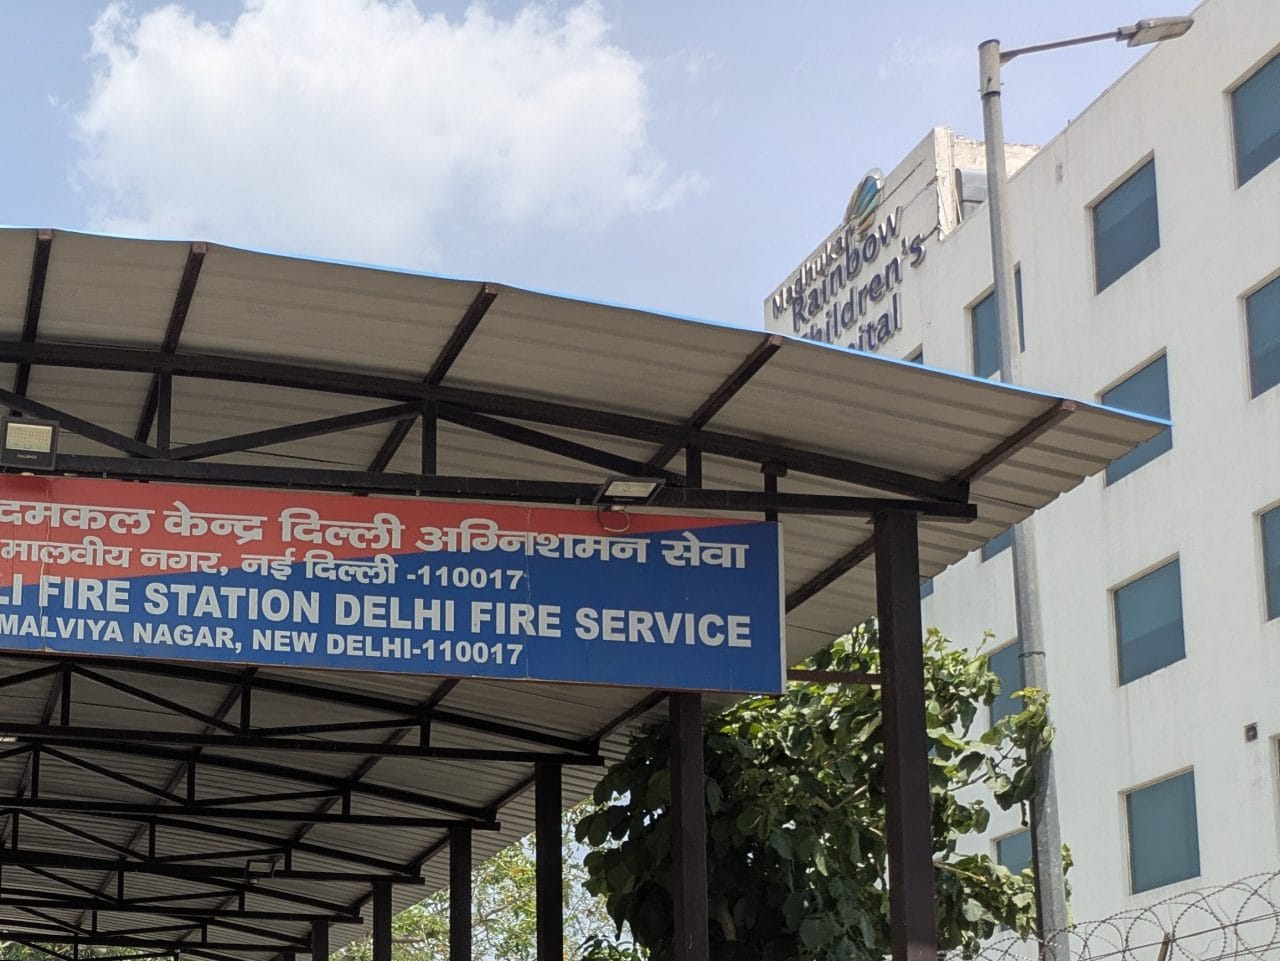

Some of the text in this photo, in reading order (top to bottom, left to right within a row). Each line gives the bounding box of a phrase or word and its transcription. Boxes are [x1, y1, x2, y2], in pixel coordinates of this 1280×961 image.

[792, 205, 903, 333] Rainbow
[0, 536, 523, 590] मालवीय नगर, नई दिल्ली -110017
[163, 501, 267, 546] केन्द्र
[280, 508, 405, 550] दिल्ली
[416, 517, 650, 563] अग्निशमन
[661, 531, 749, 569] सेवा
[39, 575, 129, 613] FIRE
[144, 583, 319, 624] STATION
[335, 594, 454, 632] DELHI
[472, 602, 561, 637] FIRE
[576, 608, 752, 647] SERVICE
[134, 623, 241, 654] NAGAR,
[253, 629, 317, 653] NEW
[326, 632, 523, 665] DELHI-110017
